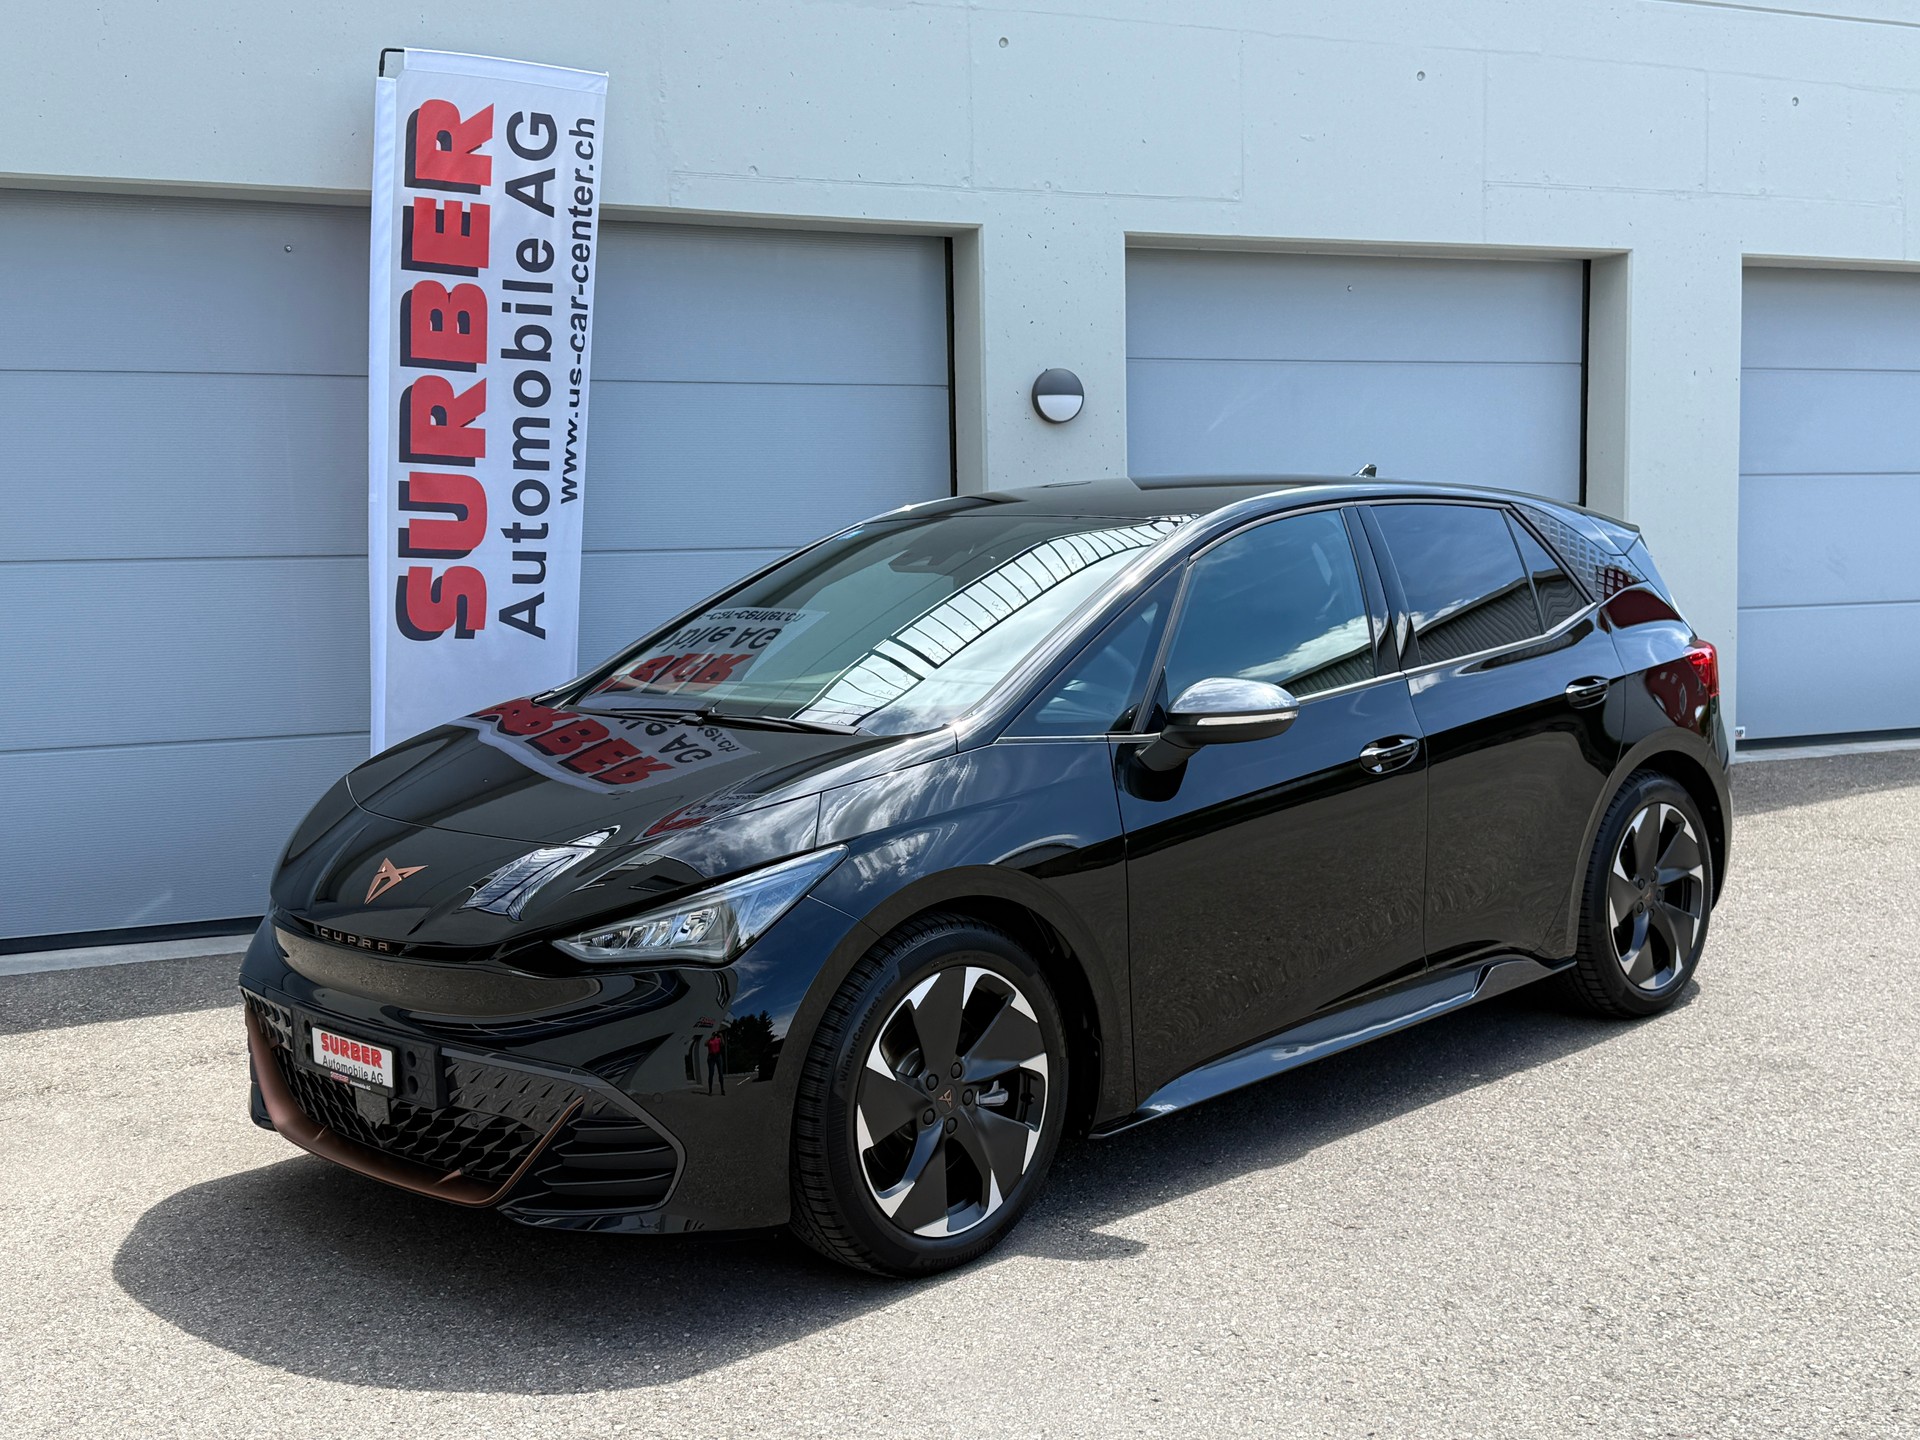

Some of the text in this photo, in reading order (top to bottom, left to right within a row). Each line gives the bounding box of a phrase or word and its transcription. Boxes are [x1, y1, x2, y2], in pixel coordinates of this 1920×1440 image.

[395, 98, 494, 641] SURBER
[499, 110, 558, 640] Automobile AG
[560, 117, 596, 505] www.us-car-center.ch
[320, 927, 388, 951] CUPRA
[321, 1032, 383, 1069] SURBER
[322, 1055, 369, 1080] Automobile
[371, 1070, 384, 1085] AG
